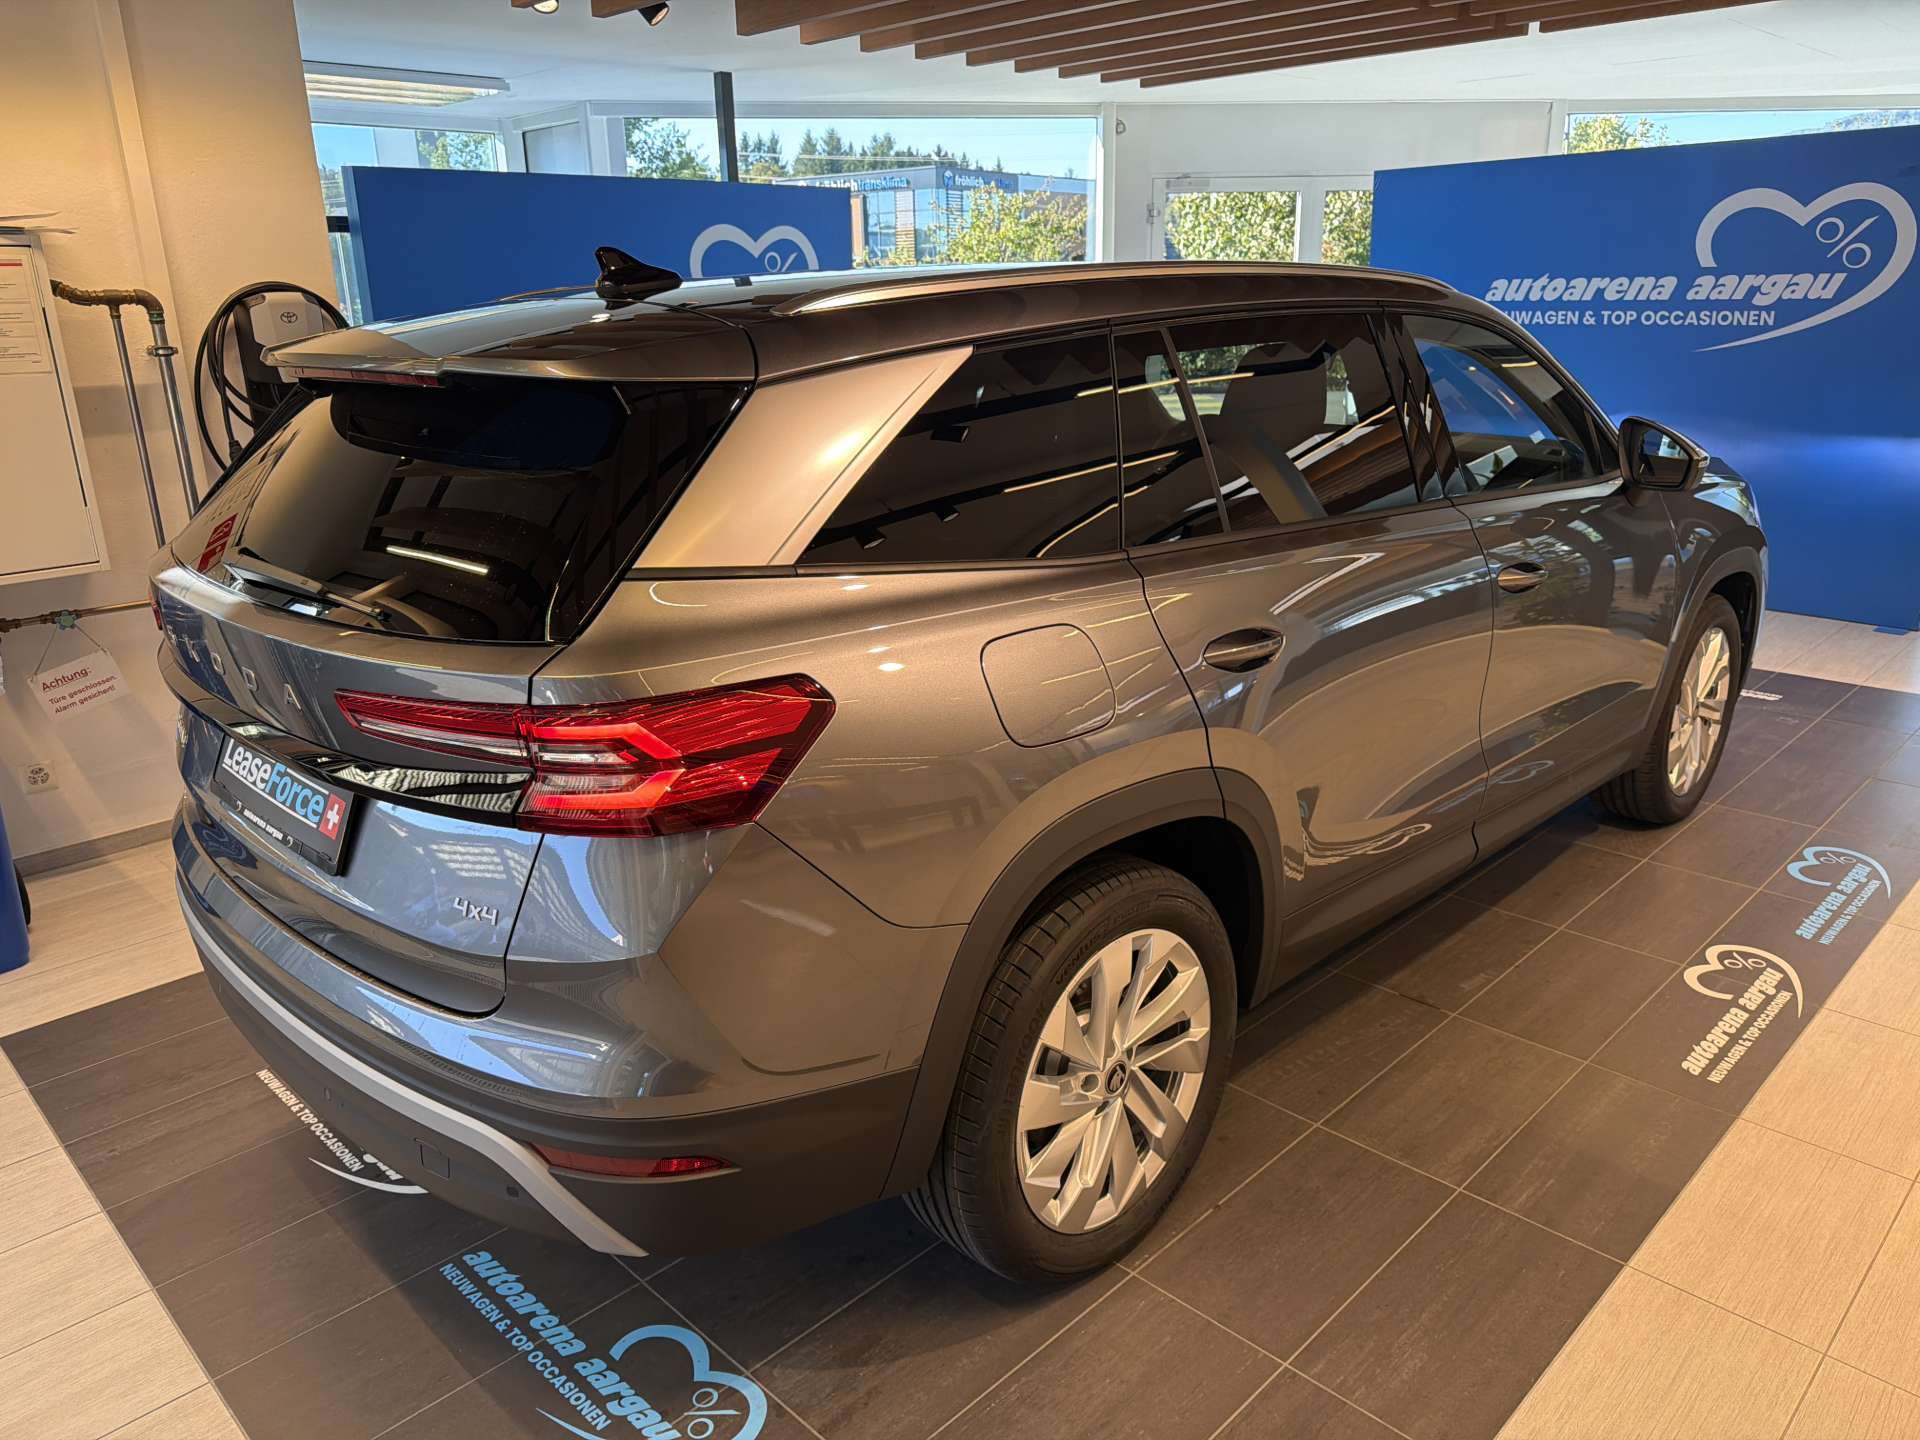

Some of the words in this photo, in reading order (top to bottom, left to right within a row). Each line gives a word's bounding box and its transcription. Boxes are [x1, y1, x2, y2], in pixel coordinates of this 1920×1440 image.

[1485, 273, 1678, 302] autoarena
[1686, 272, 1848, 306] aargau
[1505, 310, 1579, 325] UWAGEN
[1582, 310, 1597, 326] &
[1601, 310, 1637, 326] TOP
[1641, 310, 1776, 326] OCCASIONEN
[42, 666, 93, 692] Achtung:
[48, 694, 67, 705] Türe
[55, 701, 78, 714] Alarm
[223, 738, 324, 823] LeaseForce
[453, 897, 497, 926] 4x4
[1795, 891, 1848, 940] autoarena
[1836, 863, 1872, 894] aargau
[1681, 1007, 1750, 1076] autoarena
[1738, 967, 1784, 1011] aargau
[1706, 1044, 1748, 1083] NEUWAGEN
[1742, 1026, 1762, 1040] TOP
[1753, 990, 1793, 1029] OCCASIONEN
[256, 1068, 300, 1107] NEUWAGEN
[291, 1103, 304, 1112] &
[296, 1108, 318, 1124] TOP
[310, 1122, 365, 1172] OCCASIONEN
[439, 1263, 504, 1323] NEUWAGEN
[495, 1319, 511, 1333] &
[505, 1326, 534, 1351] TOP
[527, 1350, 612, 1430] OCCASIONEN
[462, 1250, 587, 1357] autoarena
[574, 1357, 682, 1440] aargau
